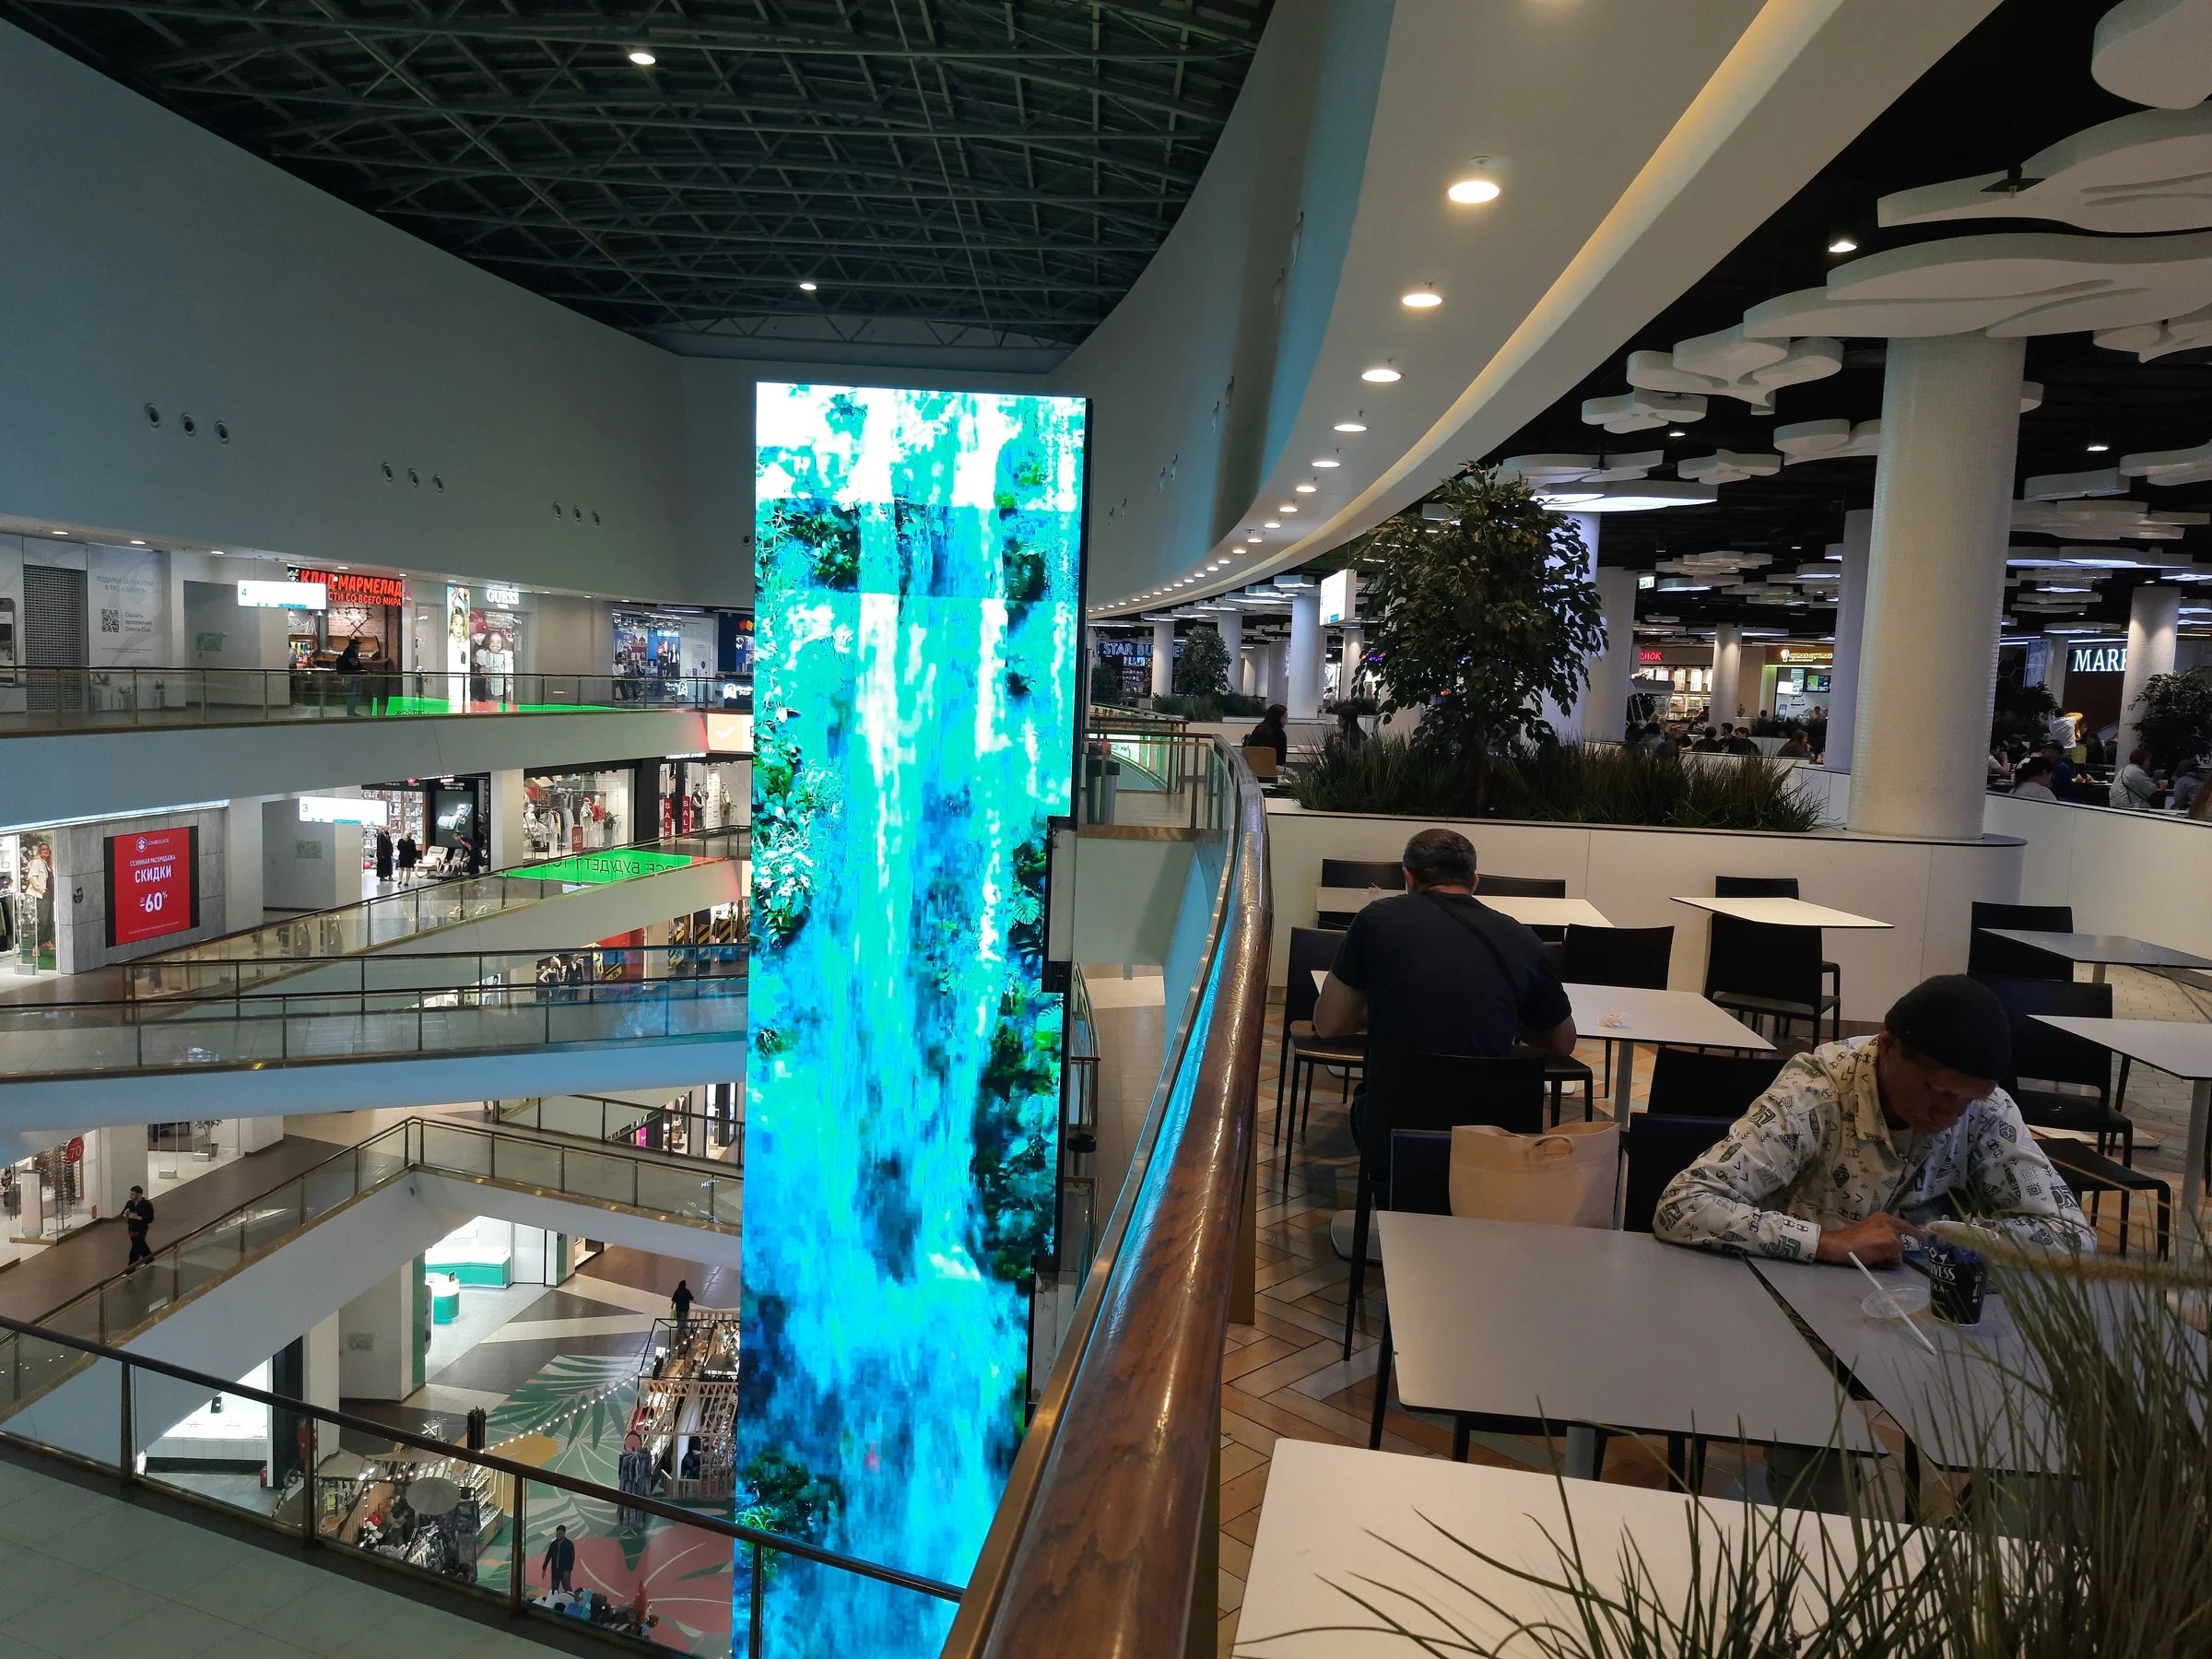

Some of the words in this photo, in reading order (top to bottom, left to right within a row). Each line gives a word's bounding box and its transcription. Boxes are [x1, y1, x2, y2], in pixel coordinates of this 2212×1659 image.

[337, 575, 403, 598] МАРМЕЛАД
[328, 591, 345, 602] СТИ
[358, 594, 382, 606] ВСЕГО
[382, 596, 403, 607] МИРА
[486, 589, 520, 606] GUESS
[1103, 642, 1133, 656] STAR
[135, 865, 171, 884] СКИДКИ
[69, 1146, 82, 1159] 70
